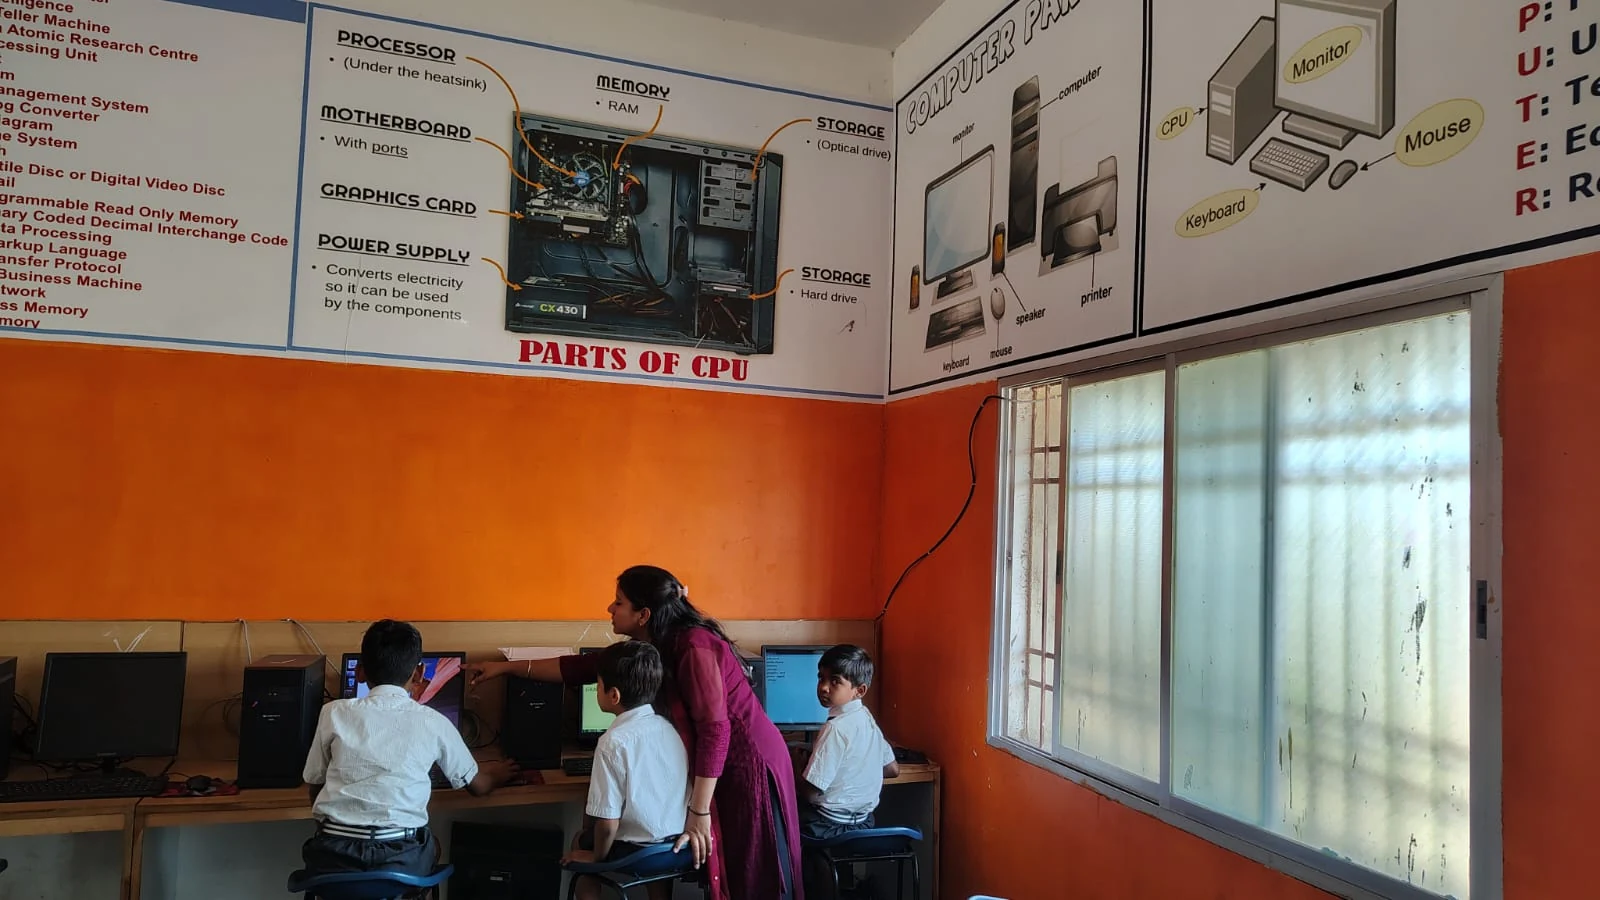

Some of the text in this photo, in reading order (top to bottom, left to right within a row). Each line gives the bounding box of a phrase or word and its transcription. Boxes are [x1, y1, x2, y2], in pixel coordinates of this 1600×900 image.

[44, 13, 110, 34] Machine
[7, 24, 65, 42] Atomic
[70, 33, 144, 54] Research
[149, 46, 199, 62] Centre
[65, 47, 98, 62] Unit
[337, 30, 456, 62] PROCESSOR
[1292, 40, 1351, 80] Monitor
[1518, 46, 1554, 76] U:
[343, 56, 487, 93] (Under the heatsink)
[905, 19, 1015, 135] COMPUTER
[1058, 66, 1102, 100] computer
[597, 75, 670, 99] MEMORY
[20, 102, 99, 122] Converter
[91, 96, 149, 115] System
[608, 100, 639, 115] RAM
[1515, 93, 1549, 122] T:
[320, 105, 471, 139] MOTHERBOARD
[817, 117, 885, 138] STORAGE
[952, 122, 975, 145] monitor
[1161, 111, 1188, 136] CPU
[17, 132, 77, 149] System
[334, 134, 408, 157] With ports
[1404, 116, 1471, 153] Mouse
[817, 138, 892, 161] (Optical drive)
[1516, 140, 1548, 170] E:
[29, 163, 64, 178] Disc
[69, 171, 86, 180] or
[91, 171, 140, 187] Digital
[146, 177, 188, 192] Video
[193, 183, 225, 197] Disc
[320, 183, 477, 215] GRAPHICS CARD
[1515, 187, 1551, 216] R:
[94, 201, 134, 216] Read
[139, 206, 174, 222] Only
[179, 210, 239, 229] Memory
[1185, 196, 1246, 231] Keyboard
[22, 223, 112, 246] Processing
[33, 210, 86, 226] Coded
[91, 216, 152, 233] Decimal
[157, 224, 246, 243] Interchange
[251, 232, 289, 247] Code
[49, 242, 127, 260] Language
[318, 234, 470, 264] POWER SUPPLY
[54, 258, 121, 274] Protocol
[326, 263, 463, 291] Converts electricity
[801, 267, 871, 285] STORAGE
[1, 284, 46, 298] twork
[77, 275, 142, 291] Machine
[325, 281, 449, 303] so it can be used
[324, 297, 342, 310] by
[347, 299, 370, 312] the
[801, 289, 858, 304] Hard drive
[1081, 285, 1113, 308] printer
[24, 301, 88, 318] Memory
[1015, 306, 1046, 326] speaker
[518, 339, 749, 381] PARTS OF CPU
[943, 355, 970, 372] keyboard
[990, 345, 1012, 359] mouse
